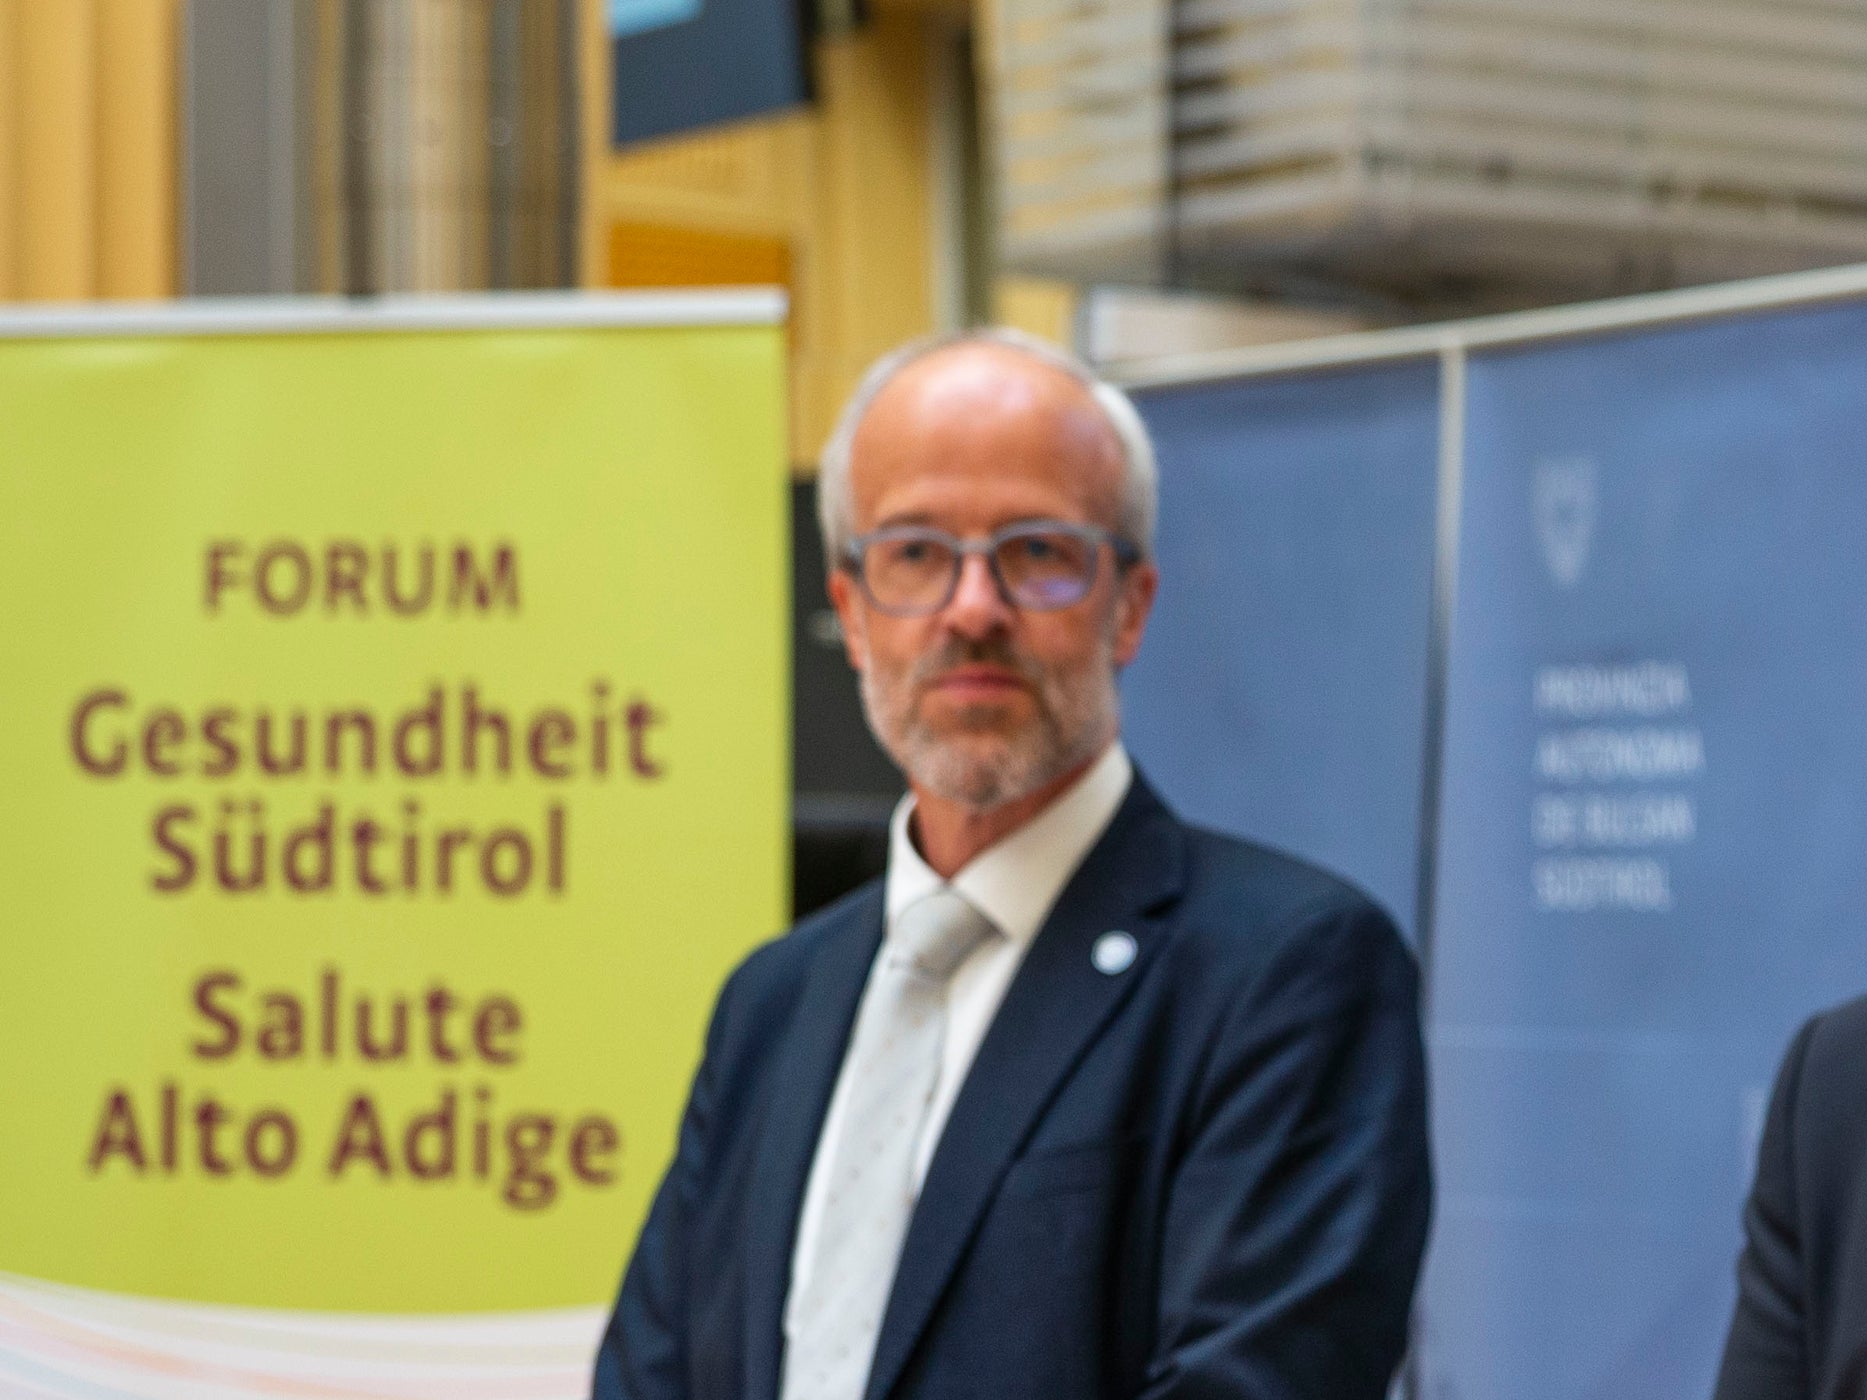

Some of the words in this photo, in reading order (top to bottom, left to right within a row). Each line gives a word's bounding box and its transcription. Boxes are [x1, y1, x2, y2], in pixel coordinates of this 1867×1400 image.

[203, 538, 522, 618] FORUM
[68, 682, 664, 782] Gesundheit
[149, 798, 567, 899] Südtirol
[189, 968, 525, 1067] Salute
[87, 1082, 300, 1180] Alto
[325, 1085, 622, 1213] Adige
